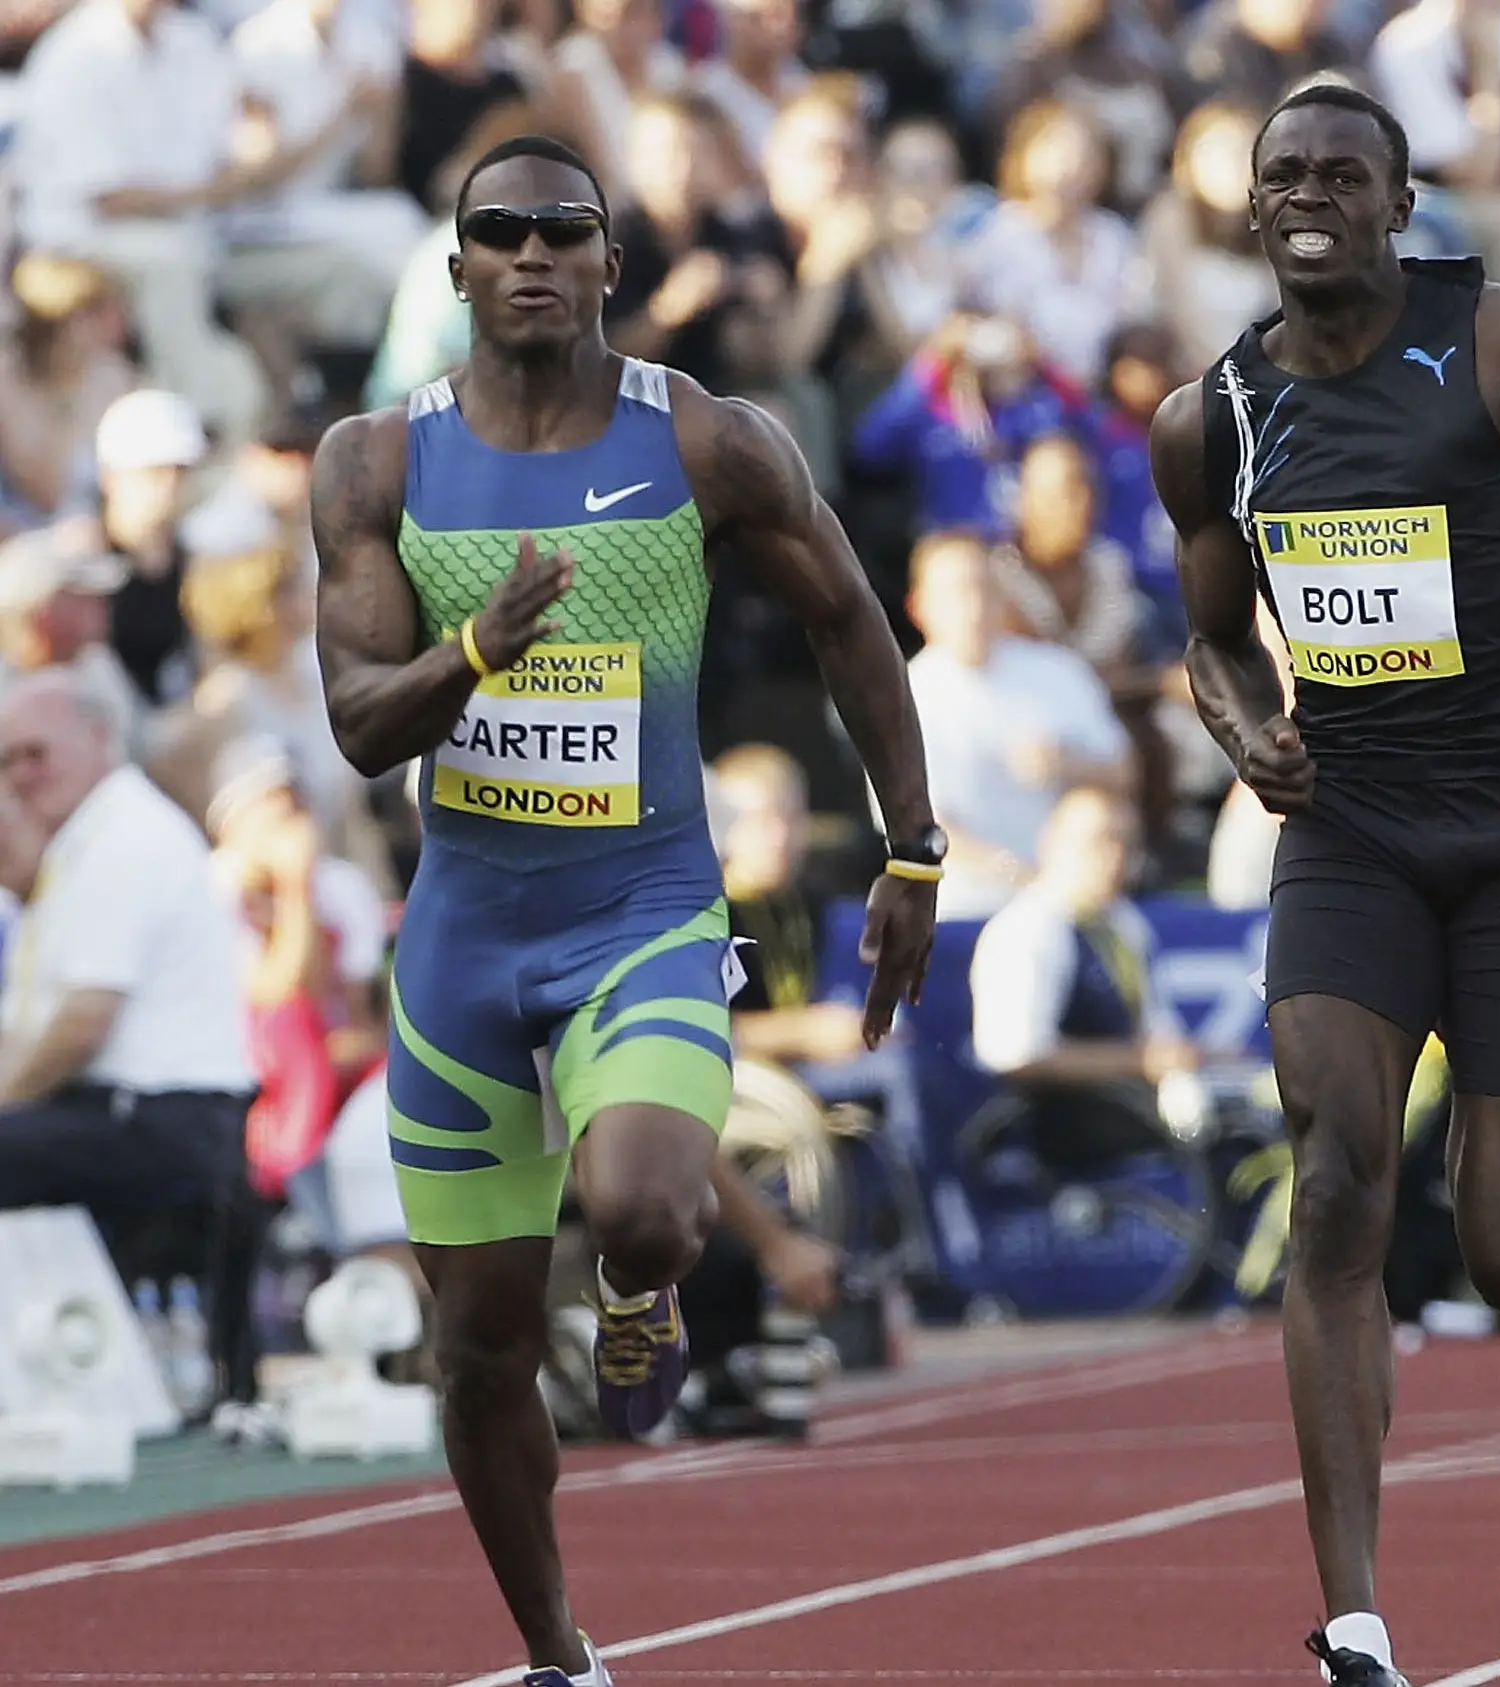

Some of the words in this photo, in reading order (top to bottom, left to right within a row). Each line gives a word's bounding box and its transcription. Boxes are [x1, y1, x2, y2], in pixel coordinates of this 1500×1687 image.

[1300, 517, 1430, 539] NORWICH
[1320, 537, 1409, 558] UNION
[1302, 587, 1399, 625] BOLT
[510, 654, 624, 673] ORWICH
[1306, 649, 1432, 677] LONDON
[509, 675, 604, 693] UNION
[463, 779, 611, 817] LONDON
